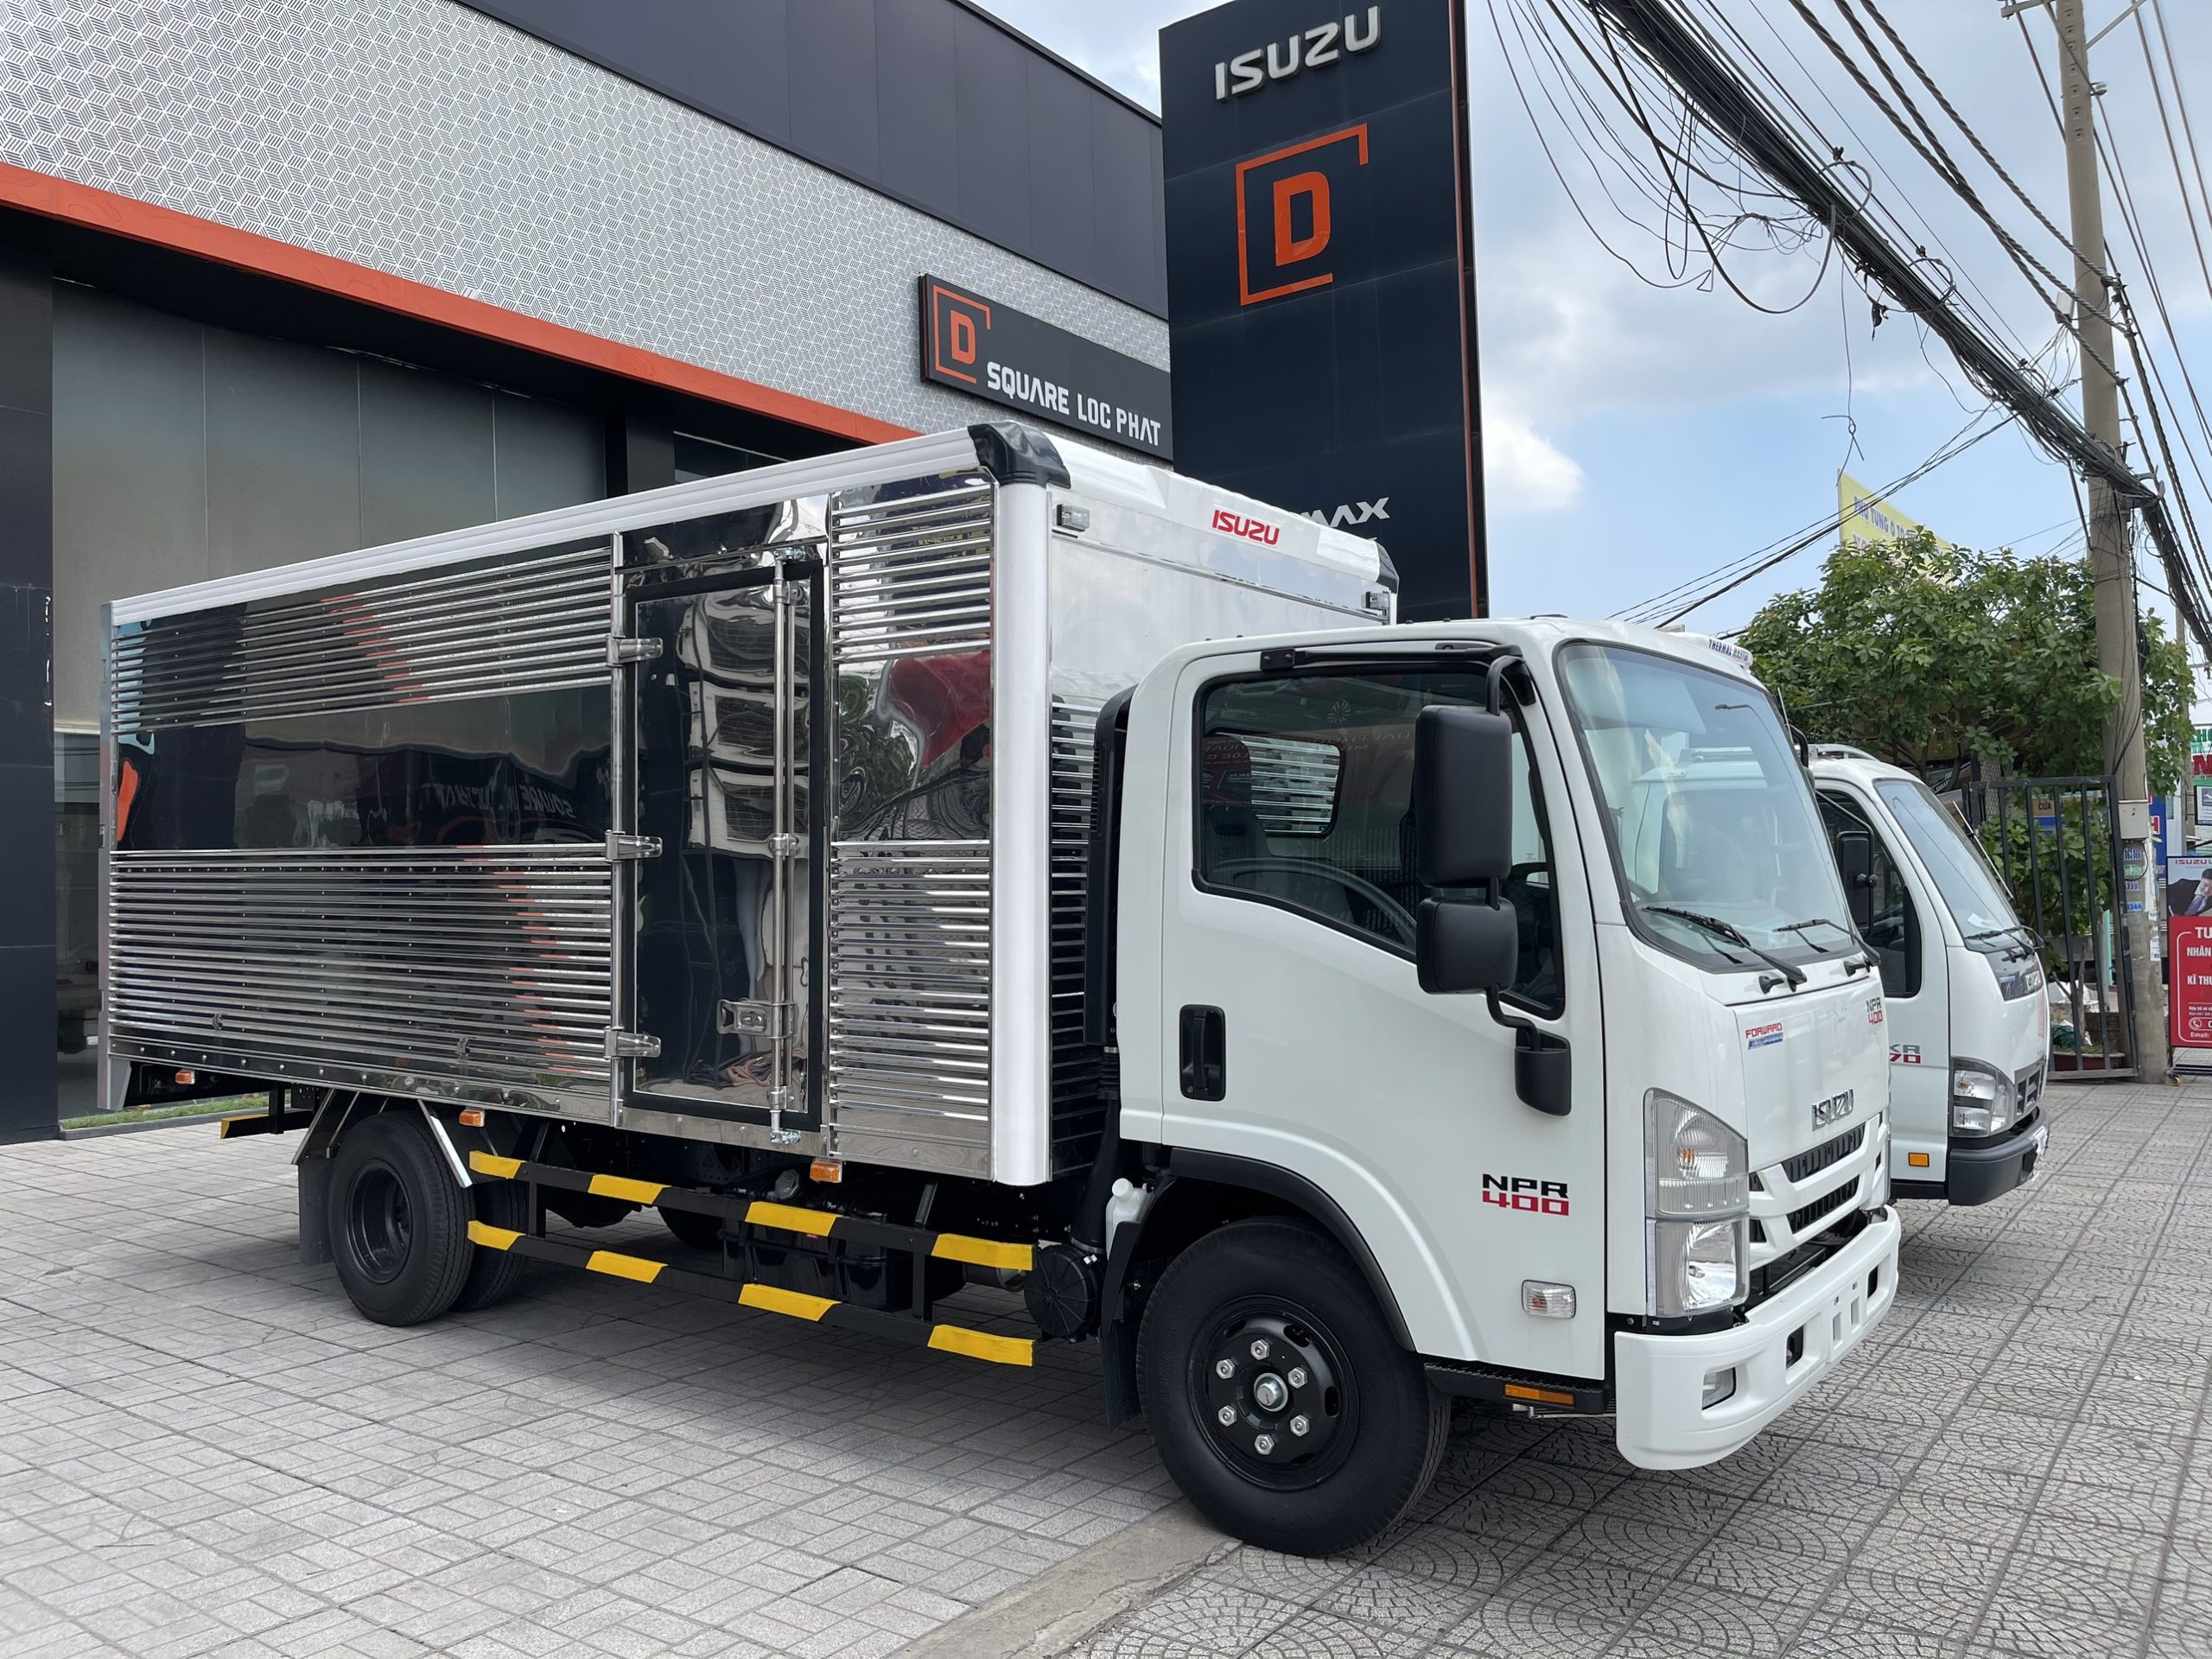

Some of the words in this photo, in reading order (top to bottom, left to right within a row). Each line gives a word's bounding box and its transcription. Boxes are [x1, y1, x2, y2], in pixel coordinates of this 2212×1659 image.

[1214, 5, 1381, 100] ISUZU
[1274, 171, 1331, 267] D
[950, 309, 976, 365] D
[987, 360, 1070, 416] SQUARE
[1077, 392, 1111, 429] LOC
[1116, 407, 1161, 447] PHAT
[1211, 509, 1281, 545] ISUZU
[2186, 946, 2212, 957] NHÂN
[1866, 996, 1882, 1013] NPR
[1868, 1010, 1884, 1025] 400
[1745, 1022, 1783, 1039] FORWARD
[1811, 1088, 1854, 1133] ISUZU
[1483, 1173, 1568, 1198] NPR
[1483, 1191, 1569, 1216] 400
